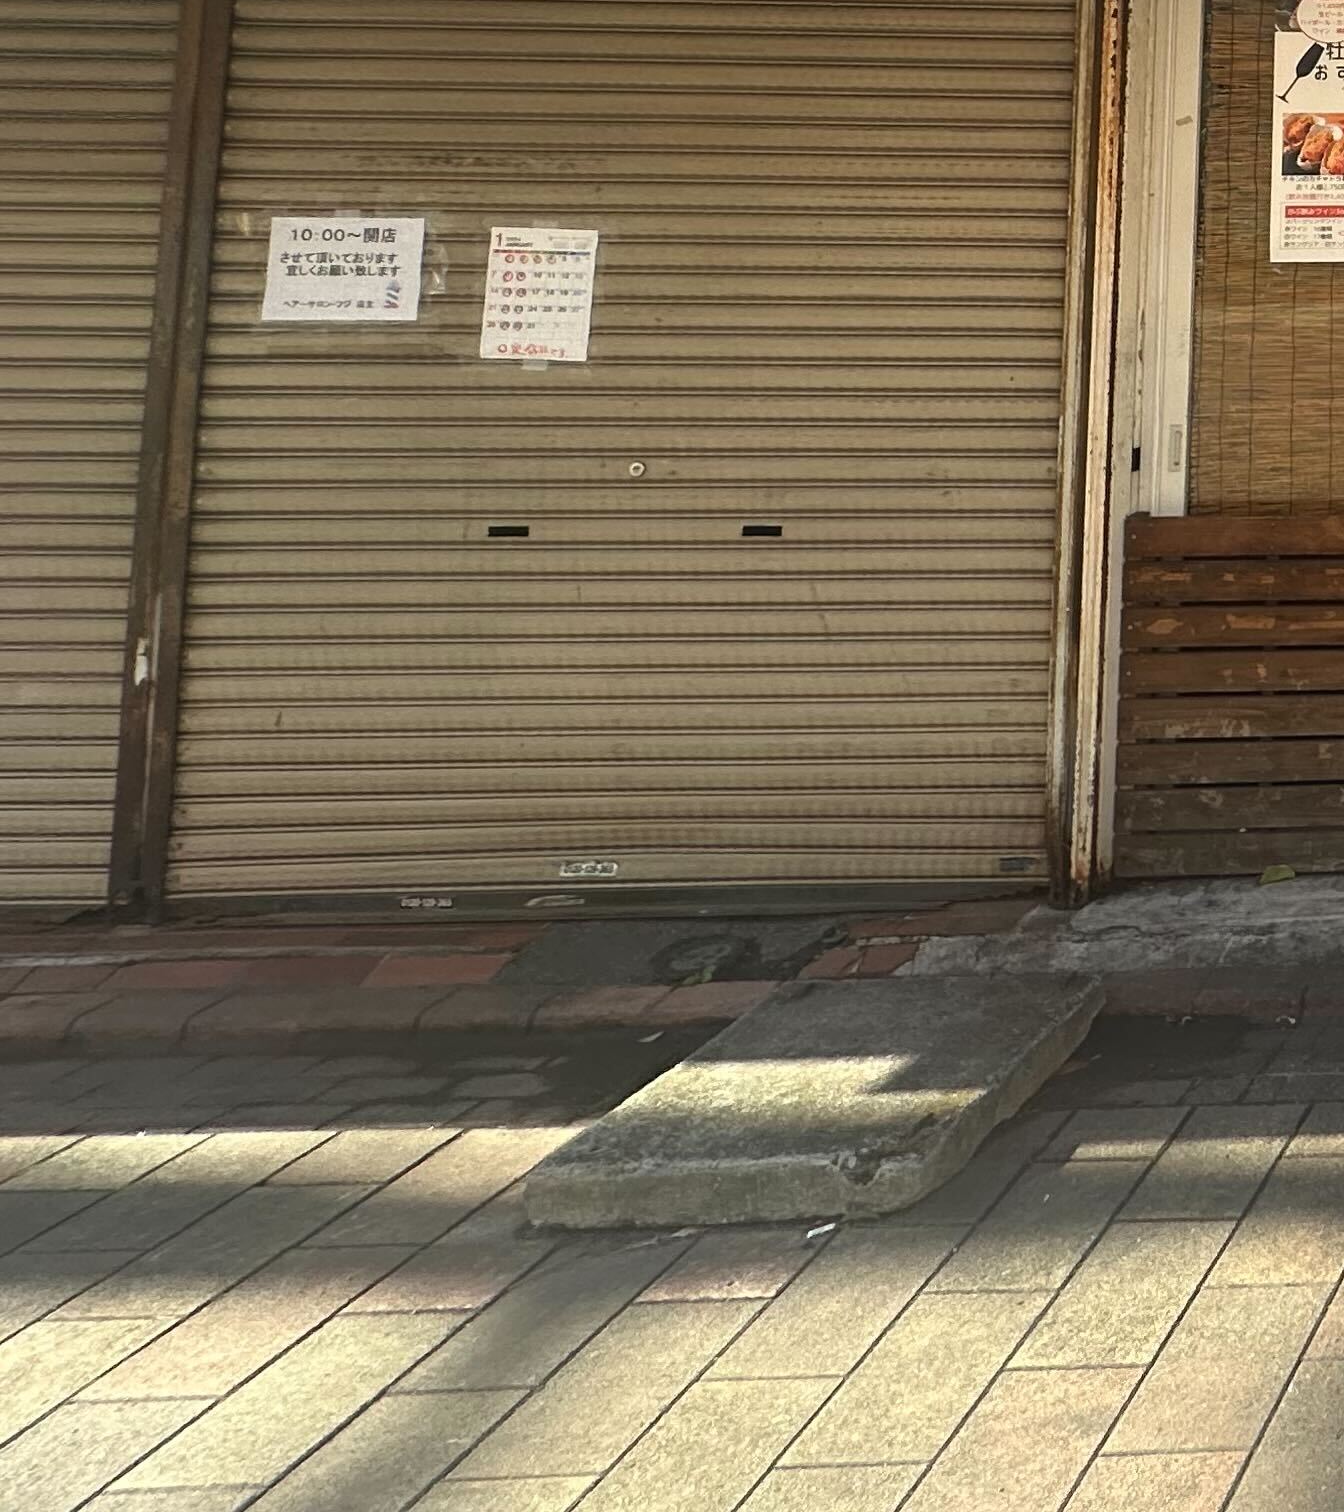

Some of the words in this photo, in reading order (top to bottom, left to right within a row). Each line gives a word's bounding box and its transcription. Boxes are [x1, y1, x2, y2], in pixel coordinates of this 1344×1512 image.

[280, 252, 398, 264] させて頂いております
[285, 265, 400, 276] 宜しくお願い致します
